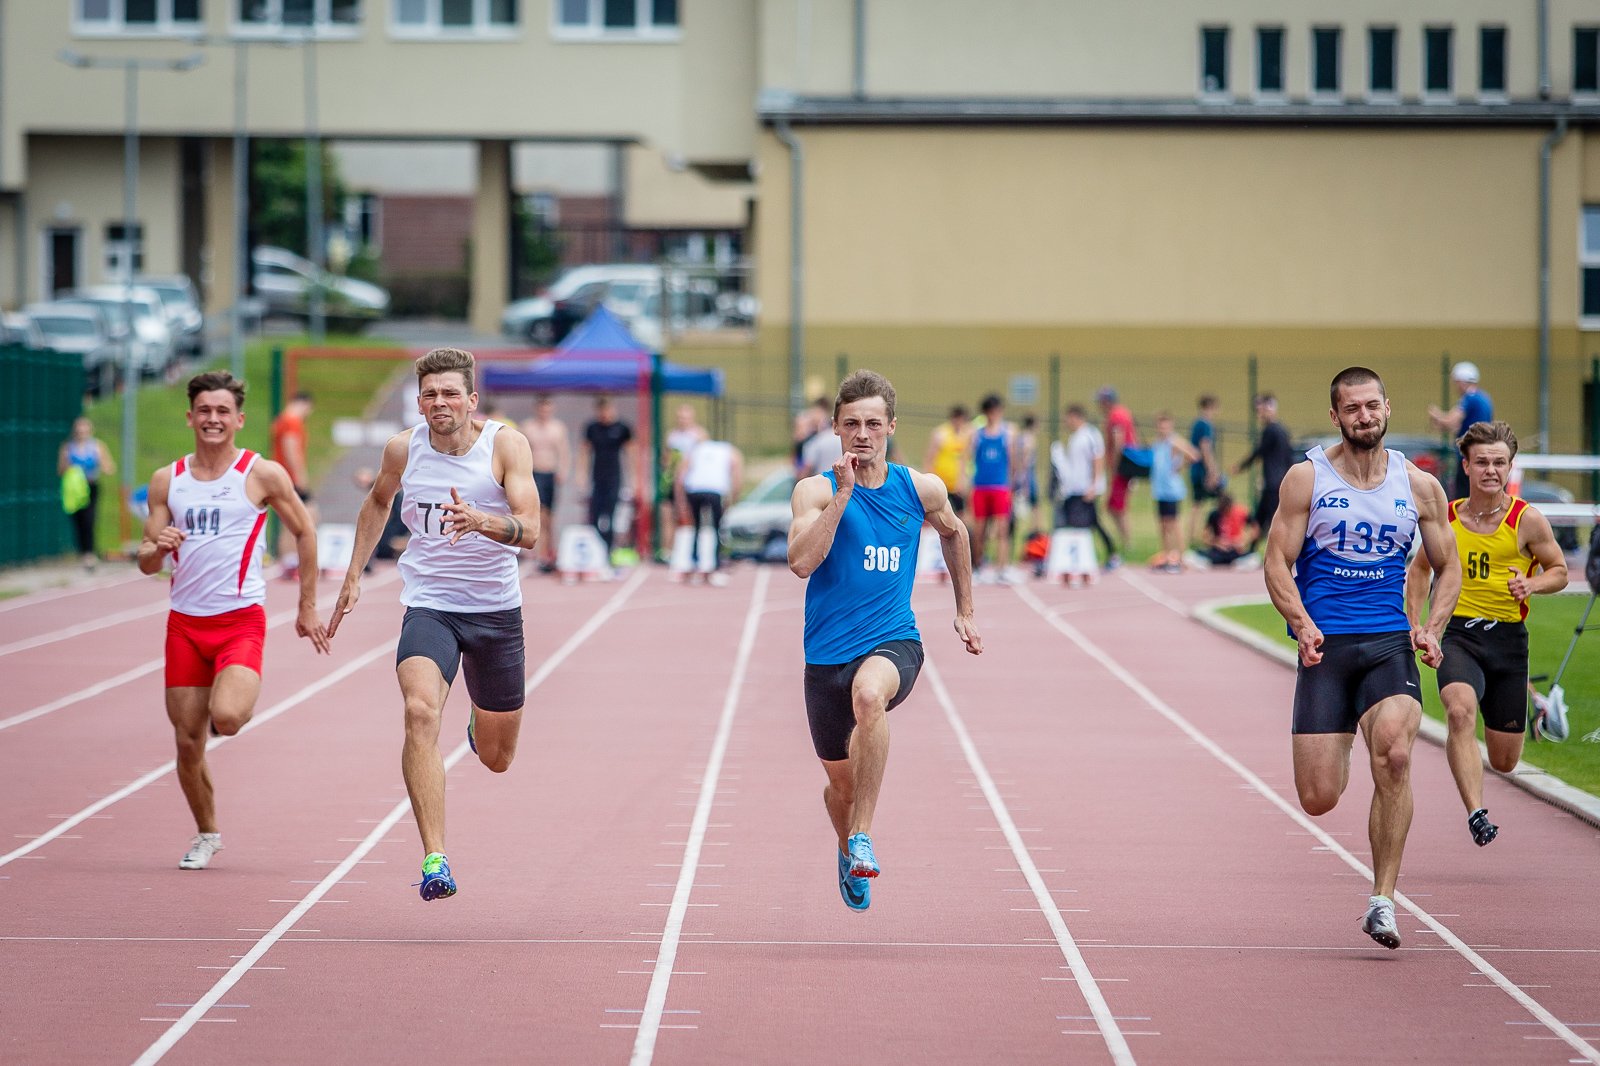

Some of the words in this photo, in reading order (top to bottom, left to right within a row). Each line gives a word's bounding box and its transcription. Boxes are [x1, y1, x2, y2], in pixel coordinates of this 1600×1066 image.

[1317, 497, 1350, 510] AZS
[417, 502, 468, 535] 77
[1331, 520, 1398, 555] 135
[863, 545, 901, 572] 309
[1467, 551, 1490, 580] 56
[1333, 567, 1385, 580] POZNAŃ
